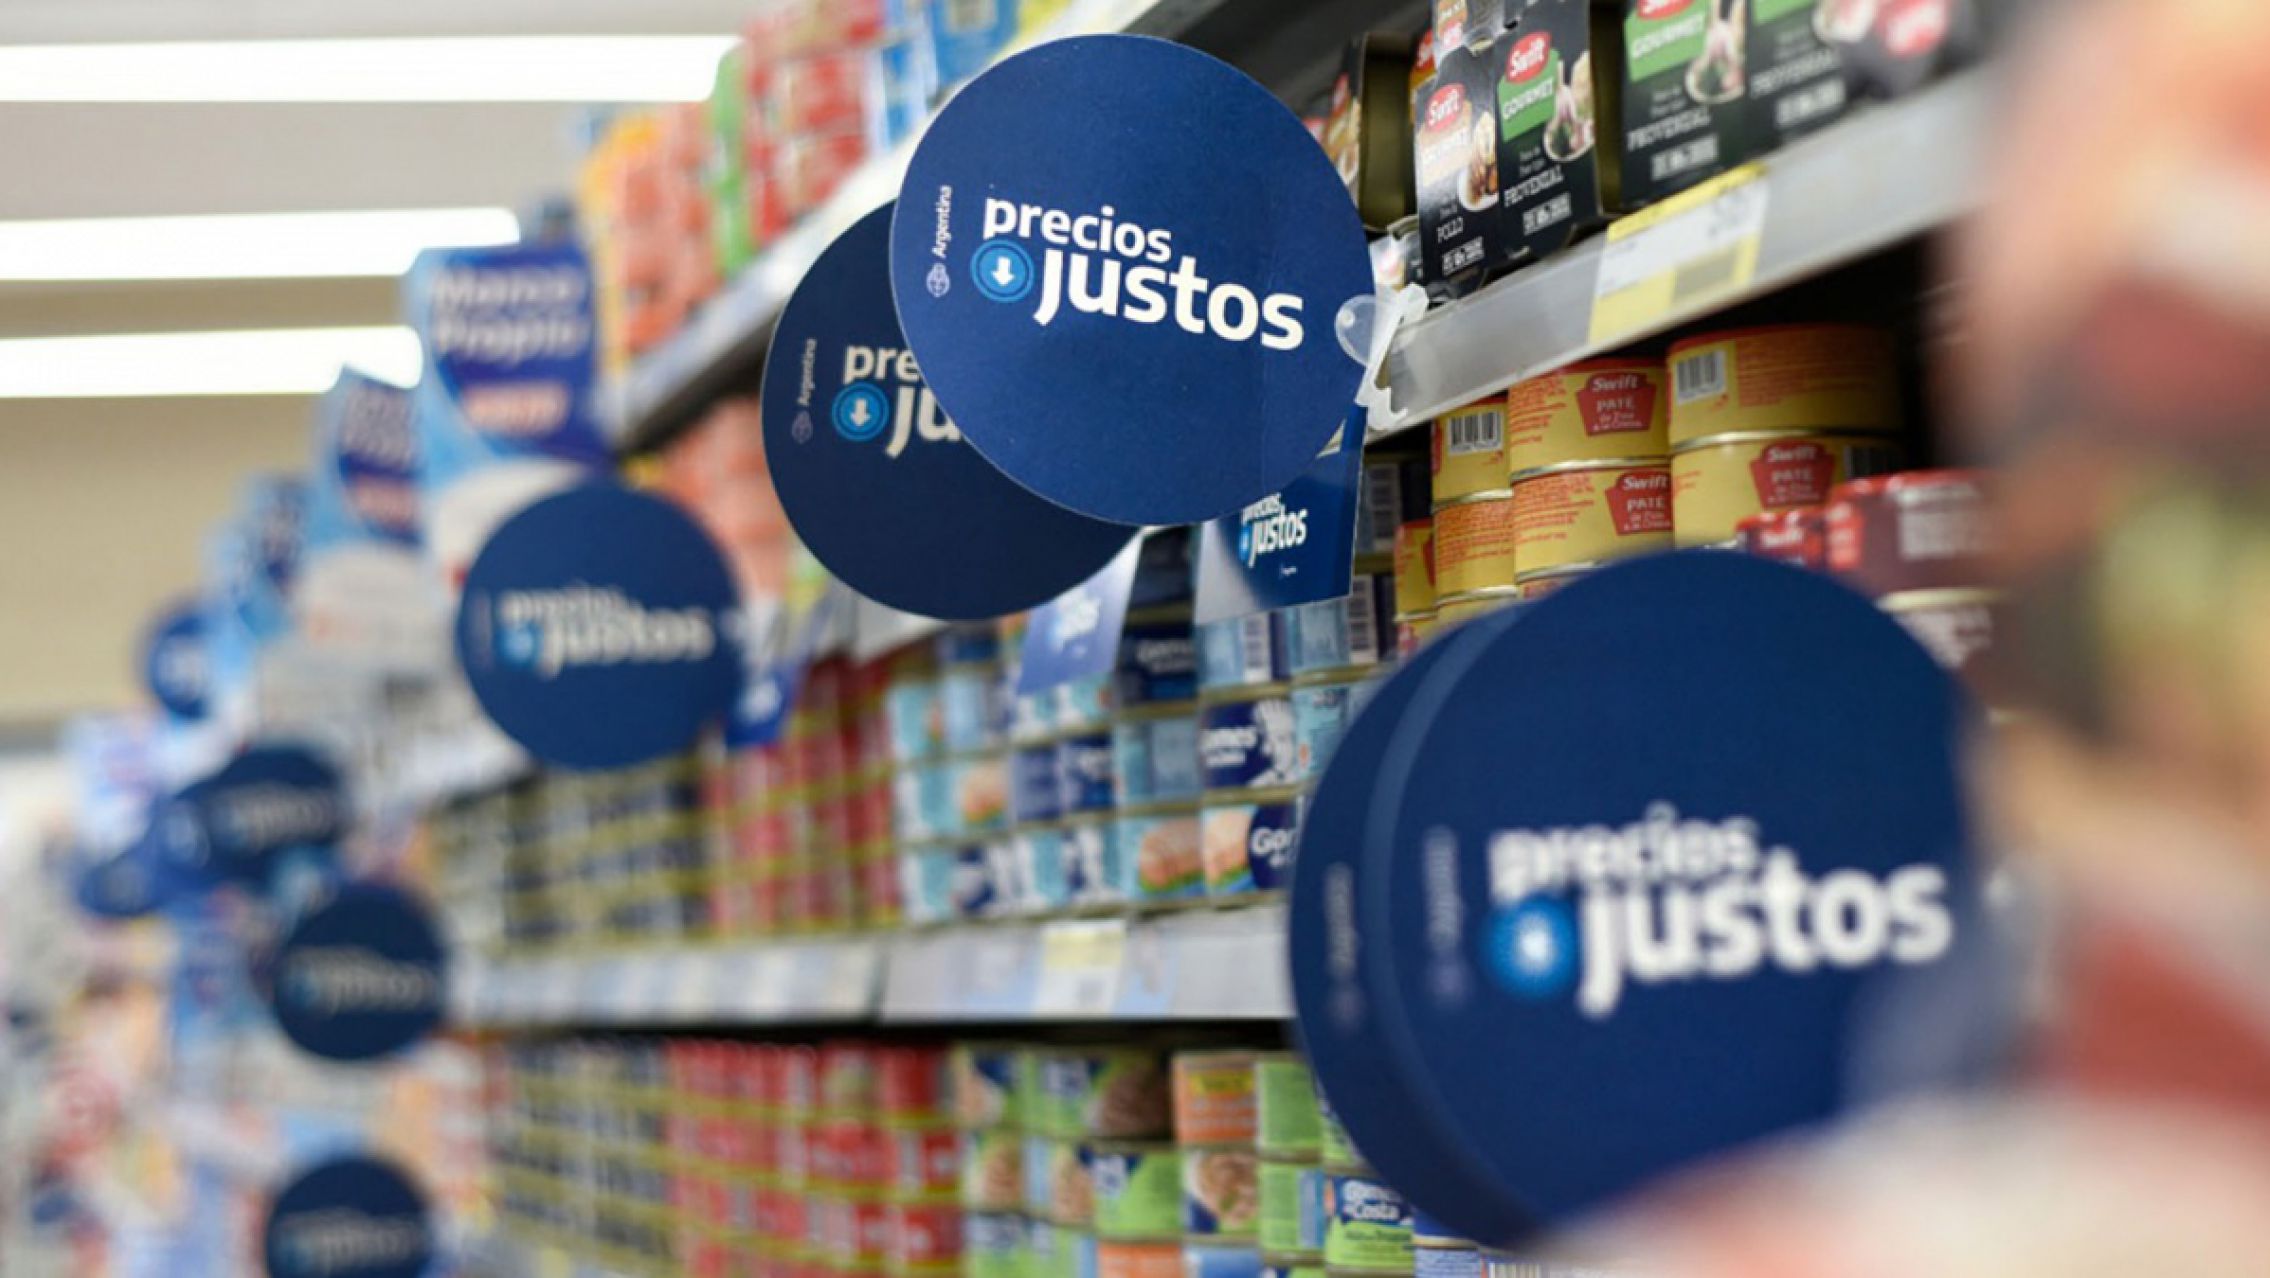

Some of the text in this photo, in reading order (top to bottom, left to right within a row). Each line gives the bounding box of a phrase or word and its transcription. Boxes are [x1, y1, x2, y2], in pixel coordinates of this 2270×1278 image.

[1508, 37, 1545, 79] Swift
[1428, 88, 1460, 128] Swift
[932, 185, 951, 258] Argentina
[983, 197, 1172, 263] precios
[1437, 216, 1464, 243] POLLO
[1034, 249, 1304, 350] justos
[1592, 374, 1638, 391] Swift
[1623, 475, 1667, 491] Swift
[1248, 509, 1307, 568] justos
[540, 600, 716, 679] justos
[1488, 800, 1758, 903] precios
[1576, 845, 1953, 1019] justos
